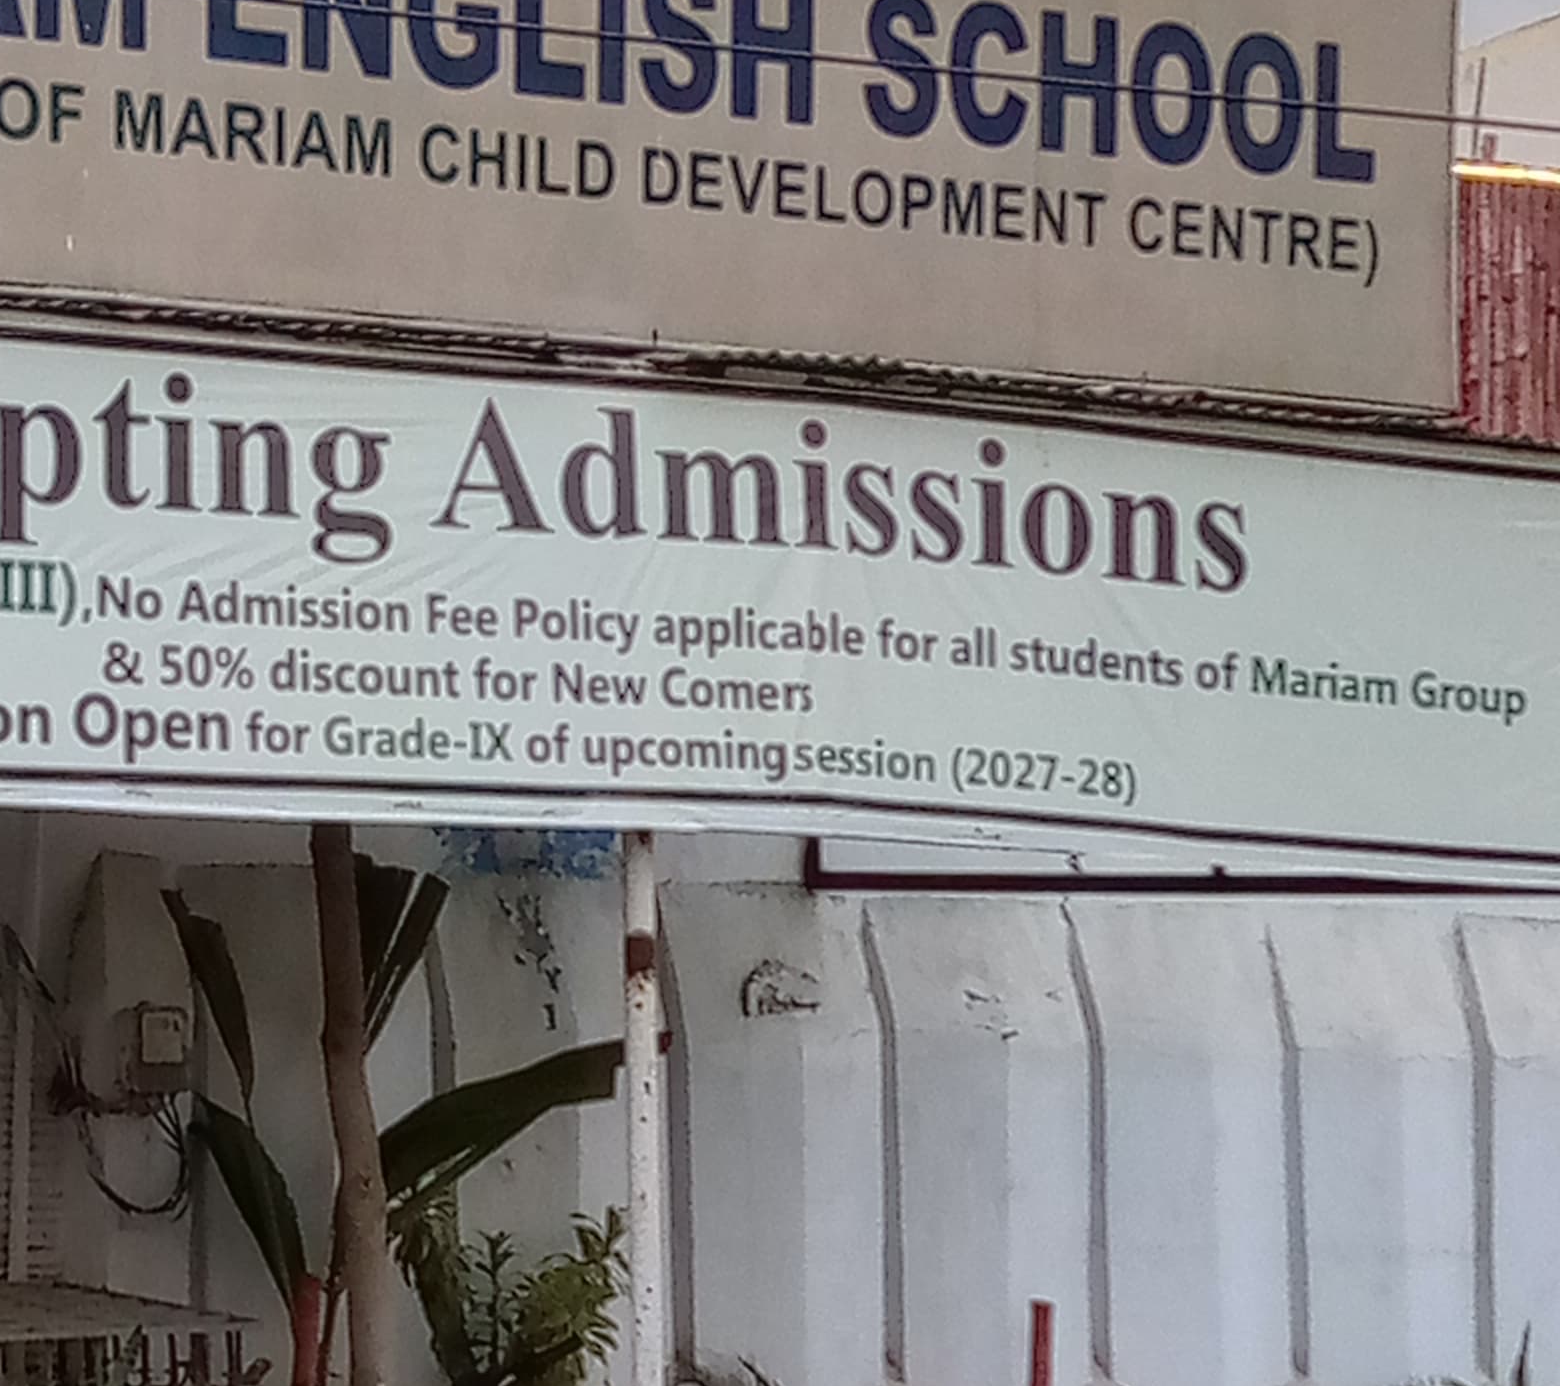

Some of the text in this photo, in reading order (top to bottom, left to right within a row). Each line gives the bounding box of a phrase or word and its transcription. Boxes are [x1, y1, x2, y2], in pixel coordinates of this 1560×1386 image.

[115, 90, 391, 177] MARIAM
[421, 124, 614, 198] CHILD
[642, 146, 1107, 247] DEVELOPMENT
[1129, 198, 1379, 288] CENTRE)
[429, 397, 1246, 593] Admissions
[98, 575, 162, 620] No
[178, 580, 409, 633] Admission
[427, 593, 498, 637] Fee
[514, 598, 640, 655] Policy
[654, 606, 865, 659] applicable
[877, 618, 939, 662] for
[951, 626, 996, 668] all
[1010, 638, 1183, 687] students
[1196, 652, 1239, 691] of
[1251, 656, 1397, 706] Mariam
[1411, 671, 1526, 727] Group
[103, 641, 813, 713] & 50% discount for New Comers
[74, 692, 229, 764] Open
[245, 710, 311, 754] for
[323, 716, 513, 762] Grade-IX
[526, 722, 570, 764] of
[583, 728, 788, 783] upcoming
[793, 738, 935, 782] session
[952, 747, 1136, 807] (2027-28)
